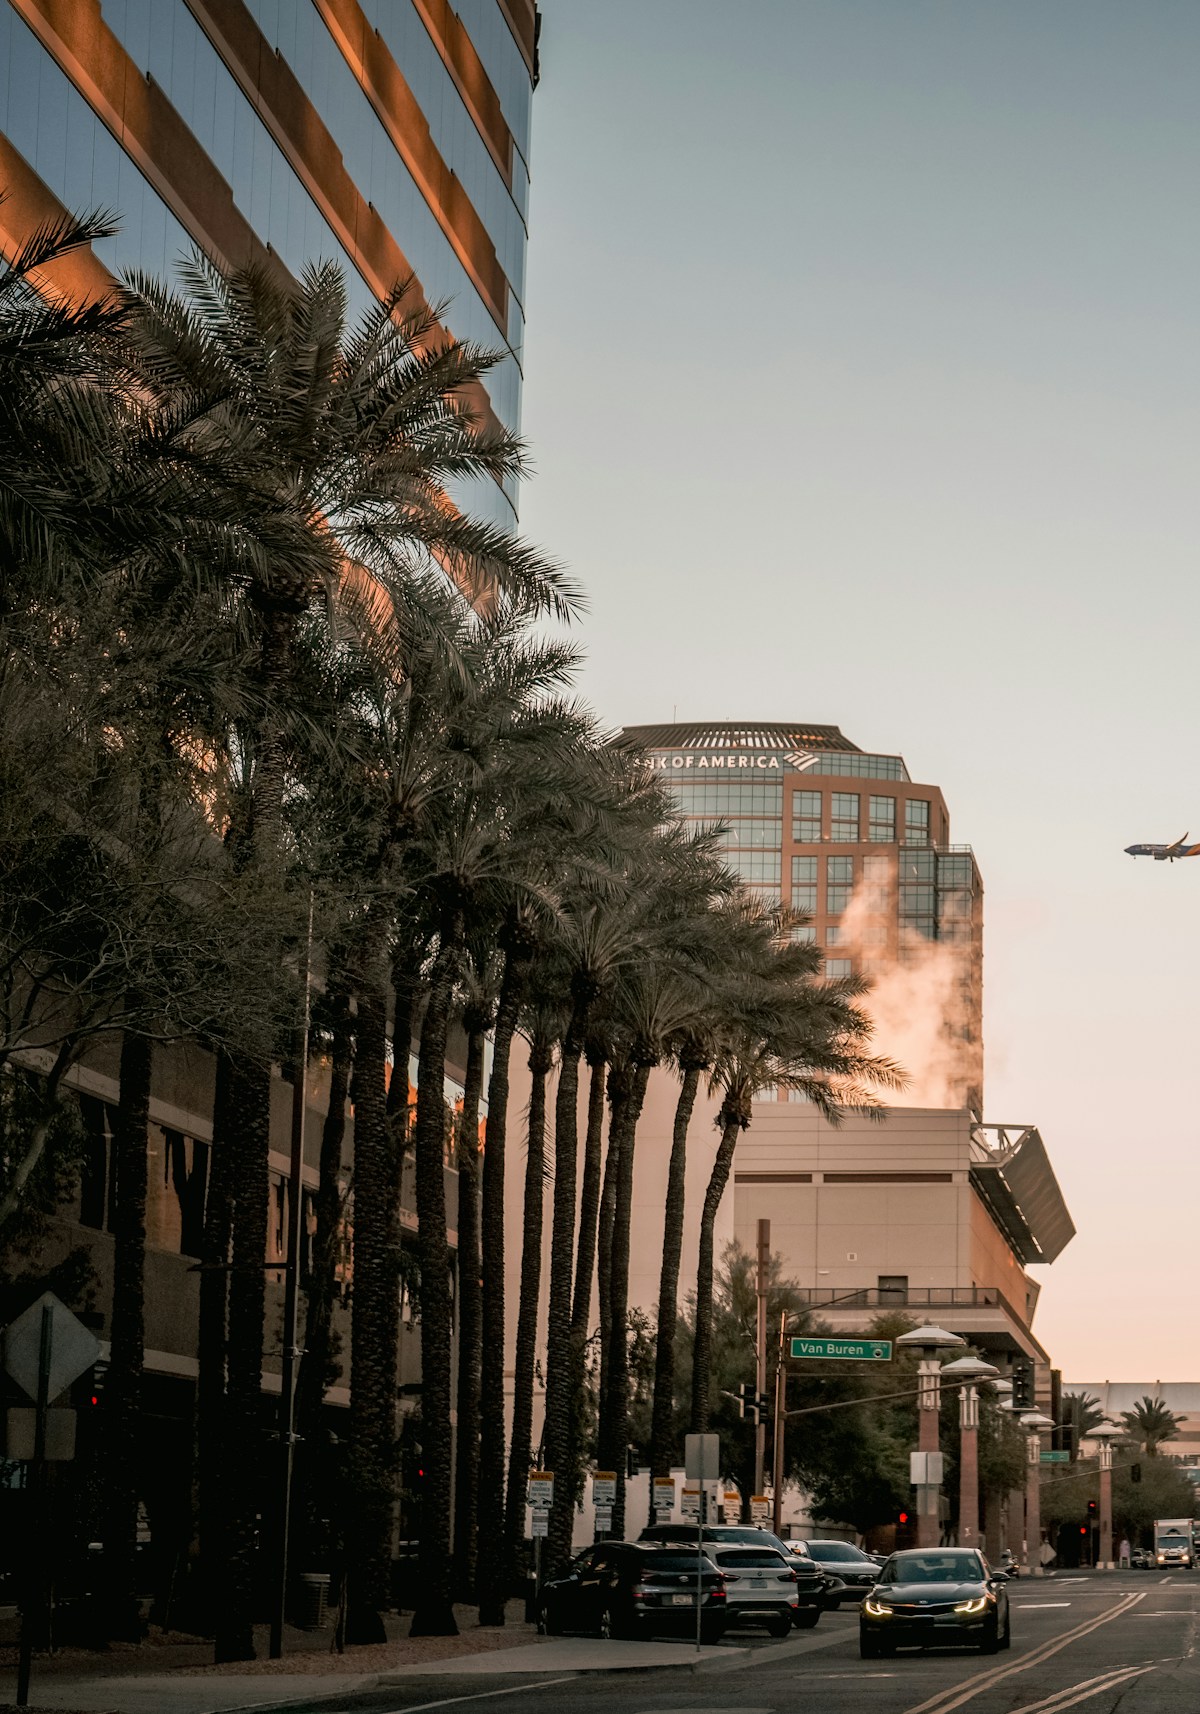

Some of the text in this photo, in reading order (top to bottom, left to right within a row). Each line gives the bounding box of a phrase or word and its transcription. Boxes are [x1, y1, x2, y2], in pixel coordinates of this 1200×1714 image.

[672, 756, 694, 769] OF
[698, 755, 780, 769] AMERICA
[800, 1343, 864, 1355] Van Buren
